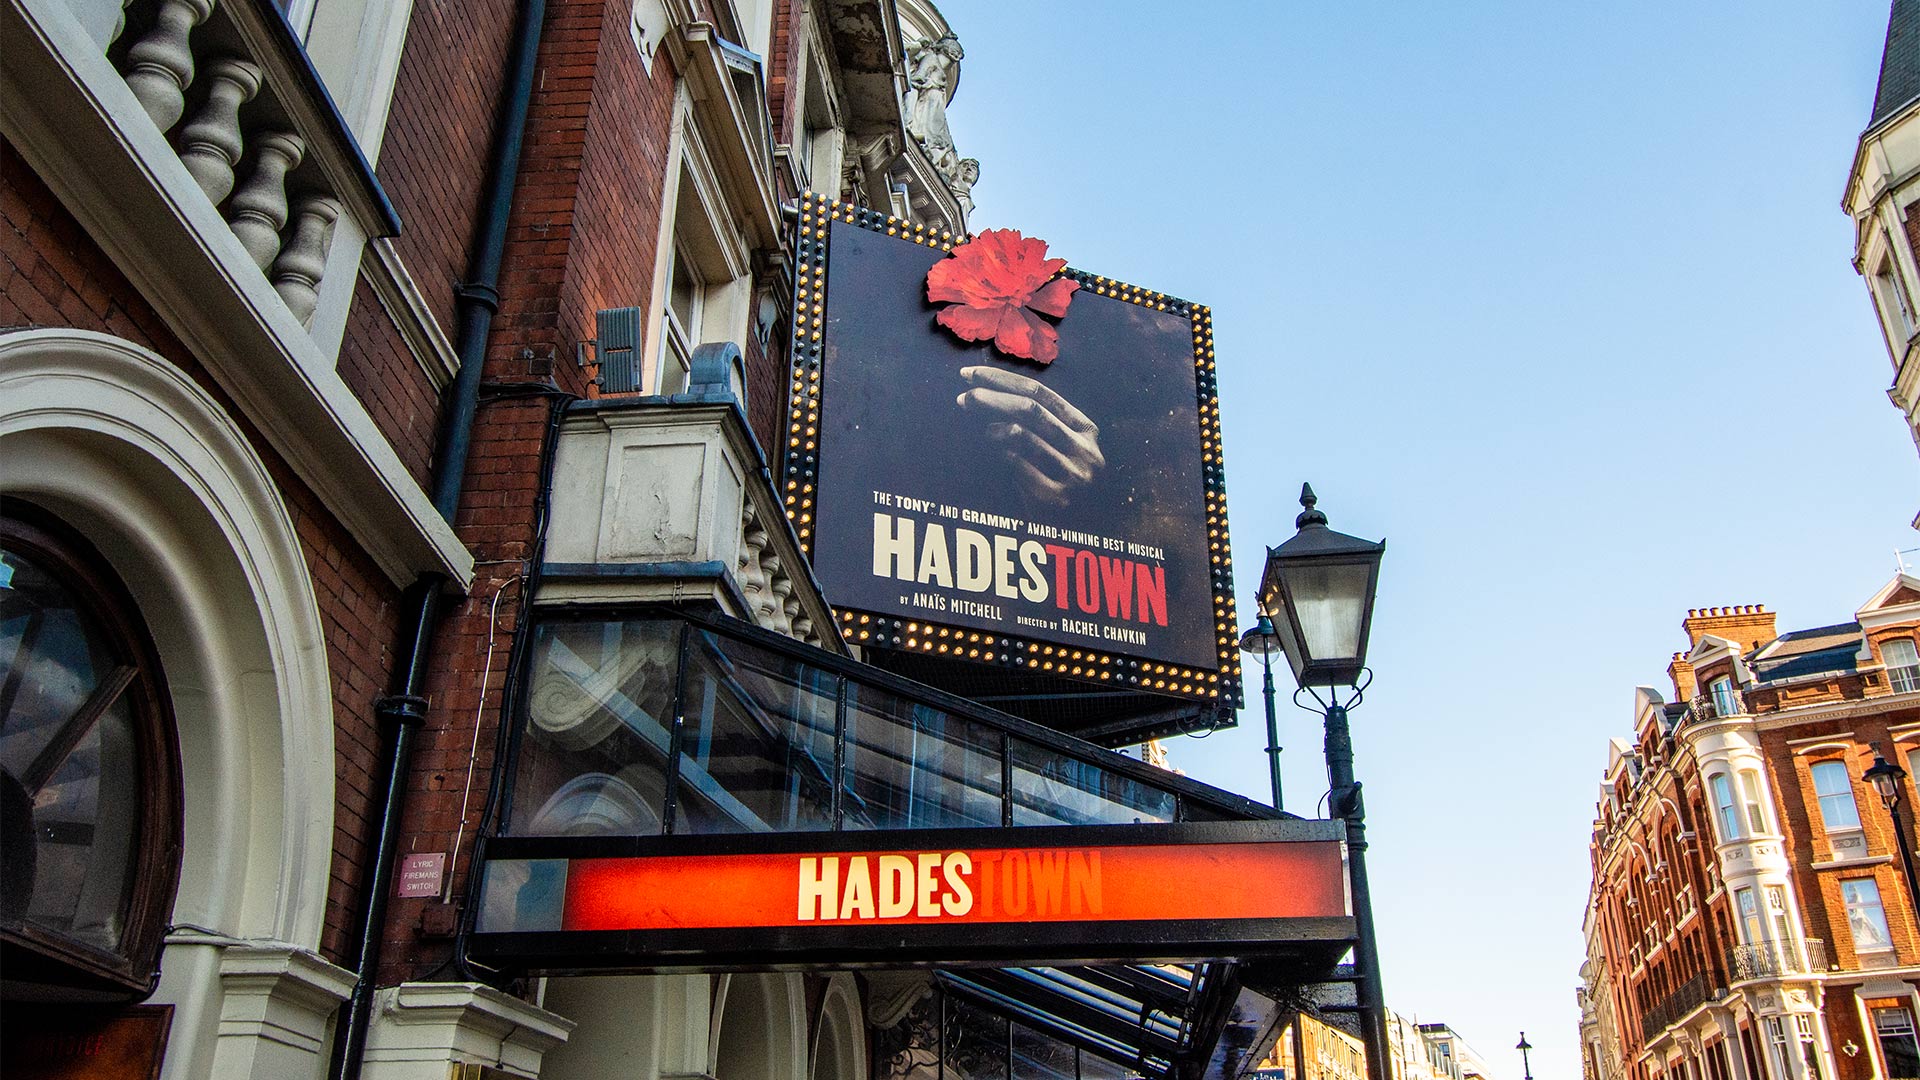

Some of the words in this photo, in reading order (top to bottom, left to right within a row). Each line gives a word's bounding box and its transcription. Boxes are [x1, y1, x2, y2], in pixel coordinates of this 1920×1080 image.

[873, 490, 892, 507] THE
[939, 503, 959, 519] AND
[1027, 522, 1100, 548] AWARD-WINNING
[1103, 537, 1125, 552] BEST
[1127, 542, 1166, 561] MUSICAL
[873, 512, 1168, 627] HADESTOWN
[900, 595, 909, 605] BY
[913, 592, 946, 611] ANAÏS
[951, 598, 1003, 620] MITCHELL
[1017, 615, 1048, 629] DIRECTED
[1049, 621, 1058, 630] BY
[1061, 618, 1101, 638] RACHEL
[1103, 625, 1147, 646] CHAVKIN
[403, 871, 439, 879] FIREMANS
[412, 860, 434, 868] LYRIC
[406, 882, 434, 890] SWITCH
[798, 850, 1102, 920] HADESTOWN
